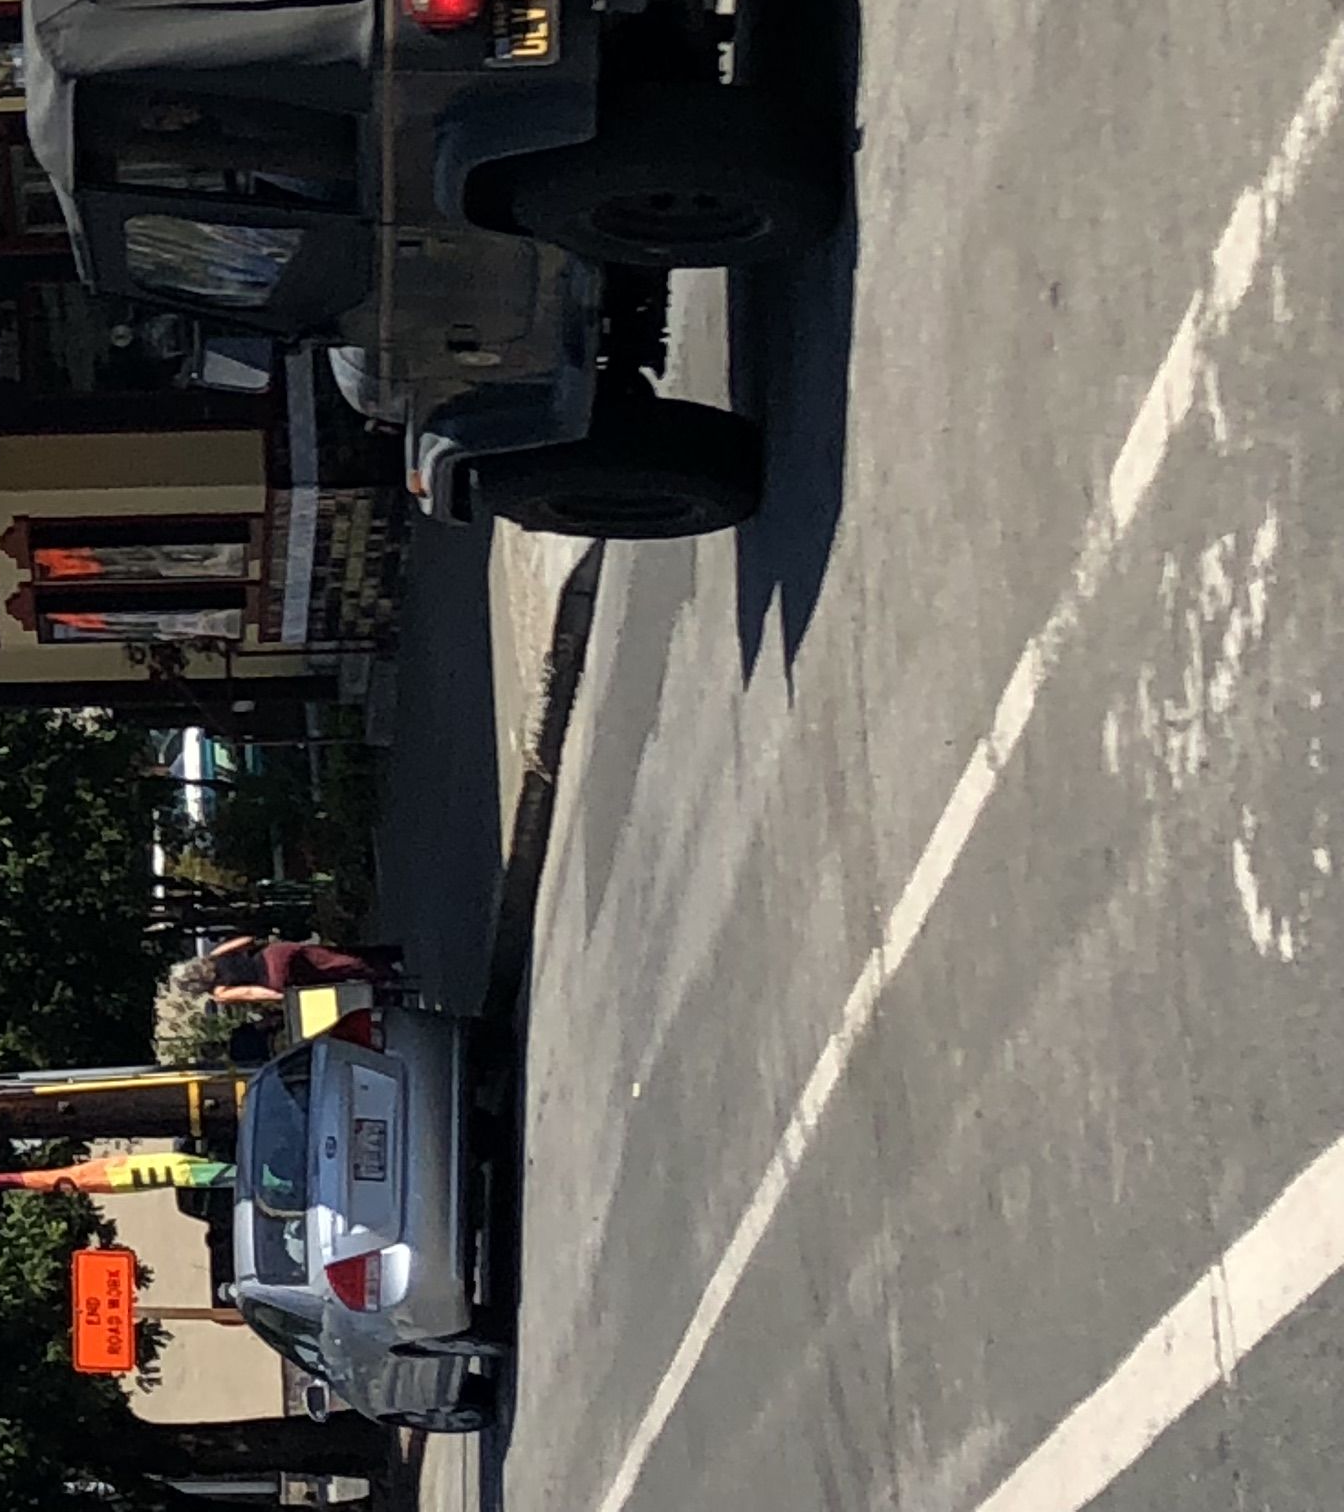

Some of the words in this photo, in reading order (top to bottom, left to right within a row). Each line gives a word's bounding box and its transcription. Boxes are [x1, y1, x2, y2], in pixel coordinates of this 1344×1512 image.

[106, 1269, 123, 1310] WORK
[85, 1296, 101, 1326] END
[106, 1315, 123, 1355] ROAD
